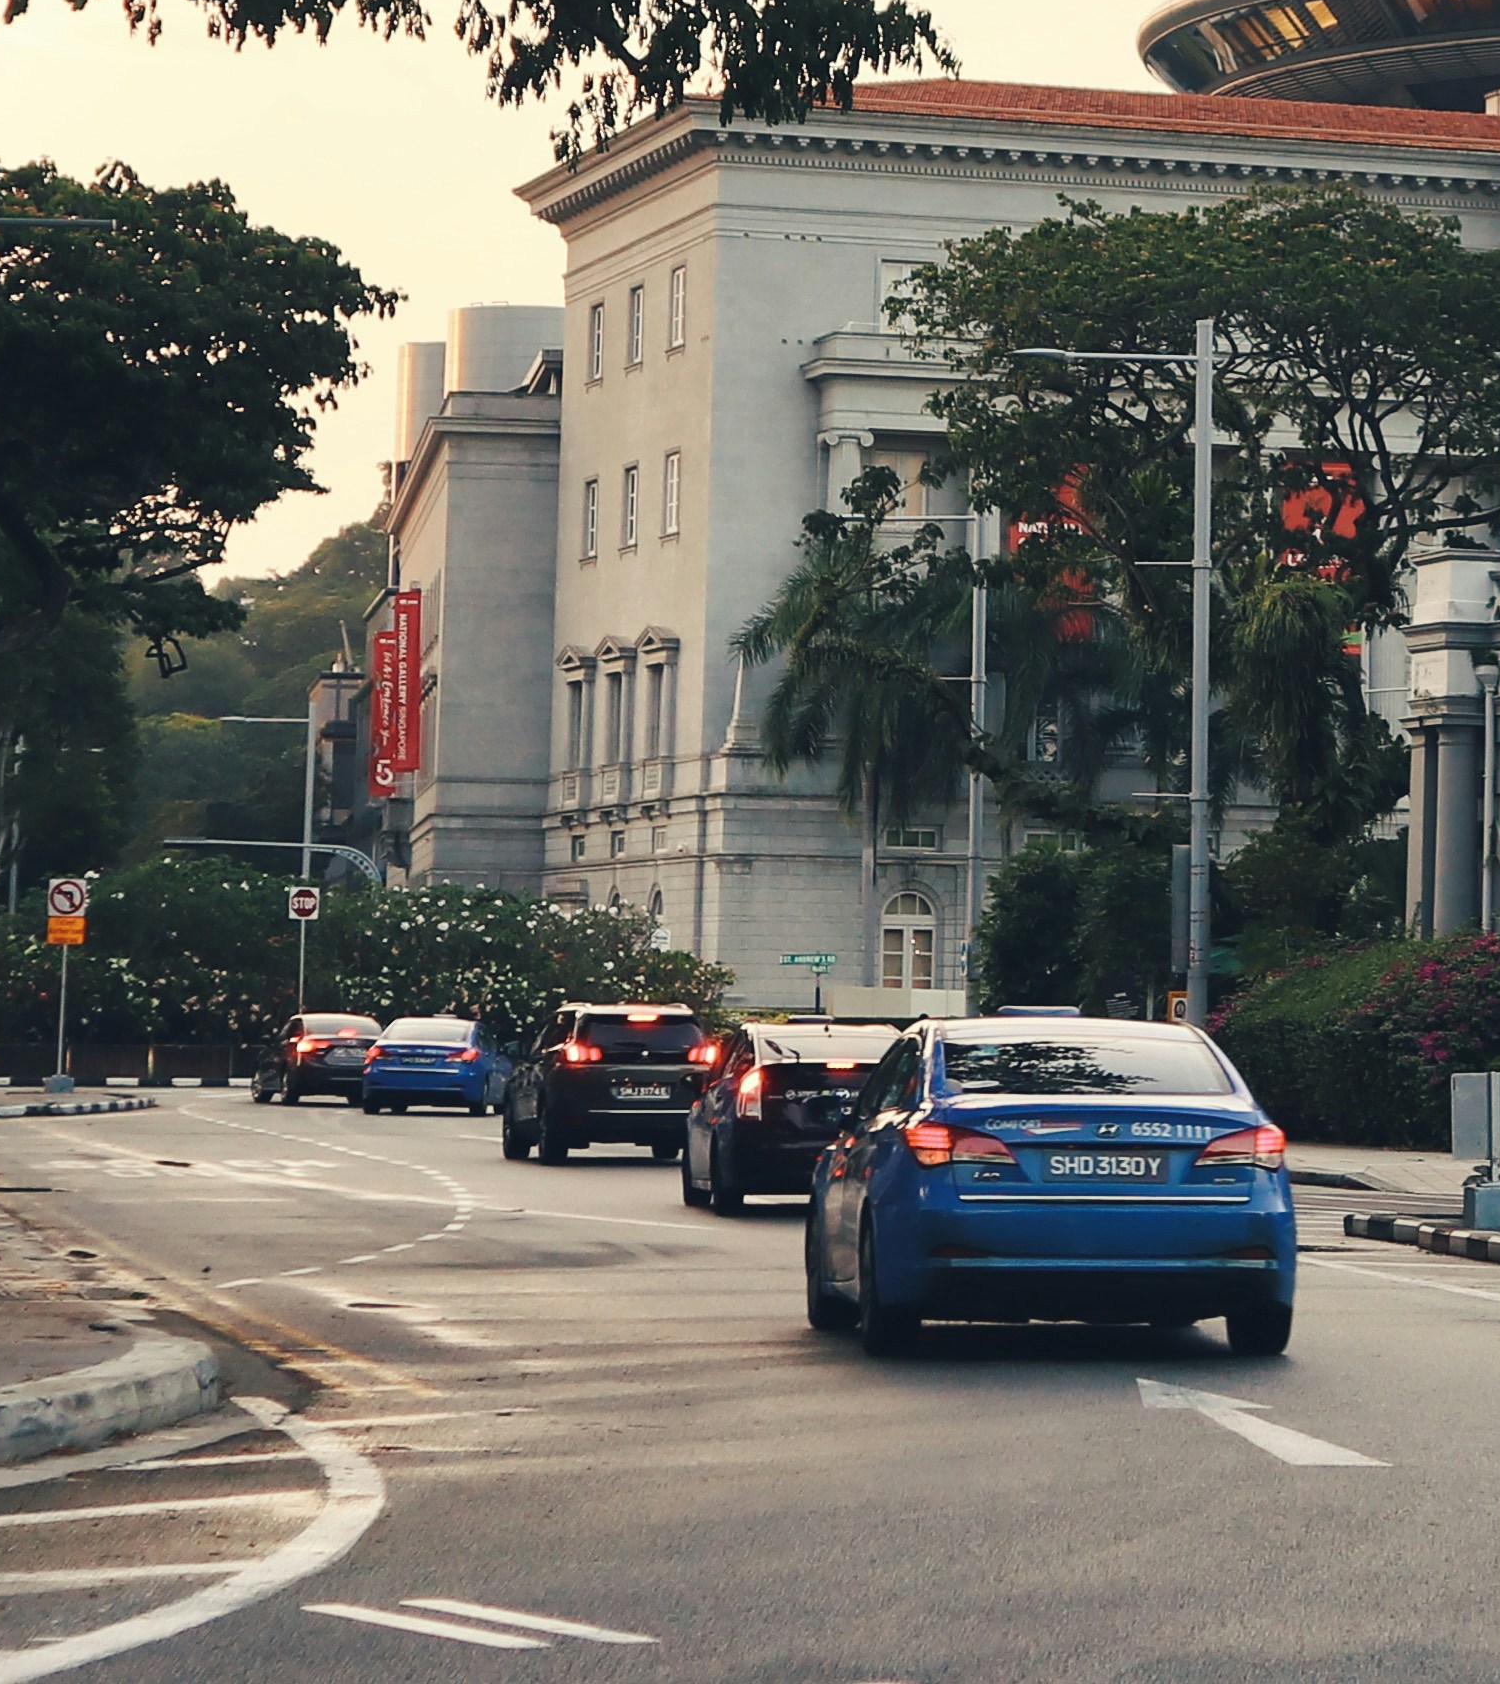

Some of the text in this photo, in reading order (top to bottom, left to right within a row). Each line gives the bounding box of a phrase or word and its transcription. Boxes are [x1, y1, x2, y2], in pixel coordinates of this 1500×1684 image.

[397, 613, 408, 761] NATIONAL GALLERY SINGAPORE
[292, 897, 316, 909] STOP
[1131, 1122, 1212, 1140] 6552 1111
